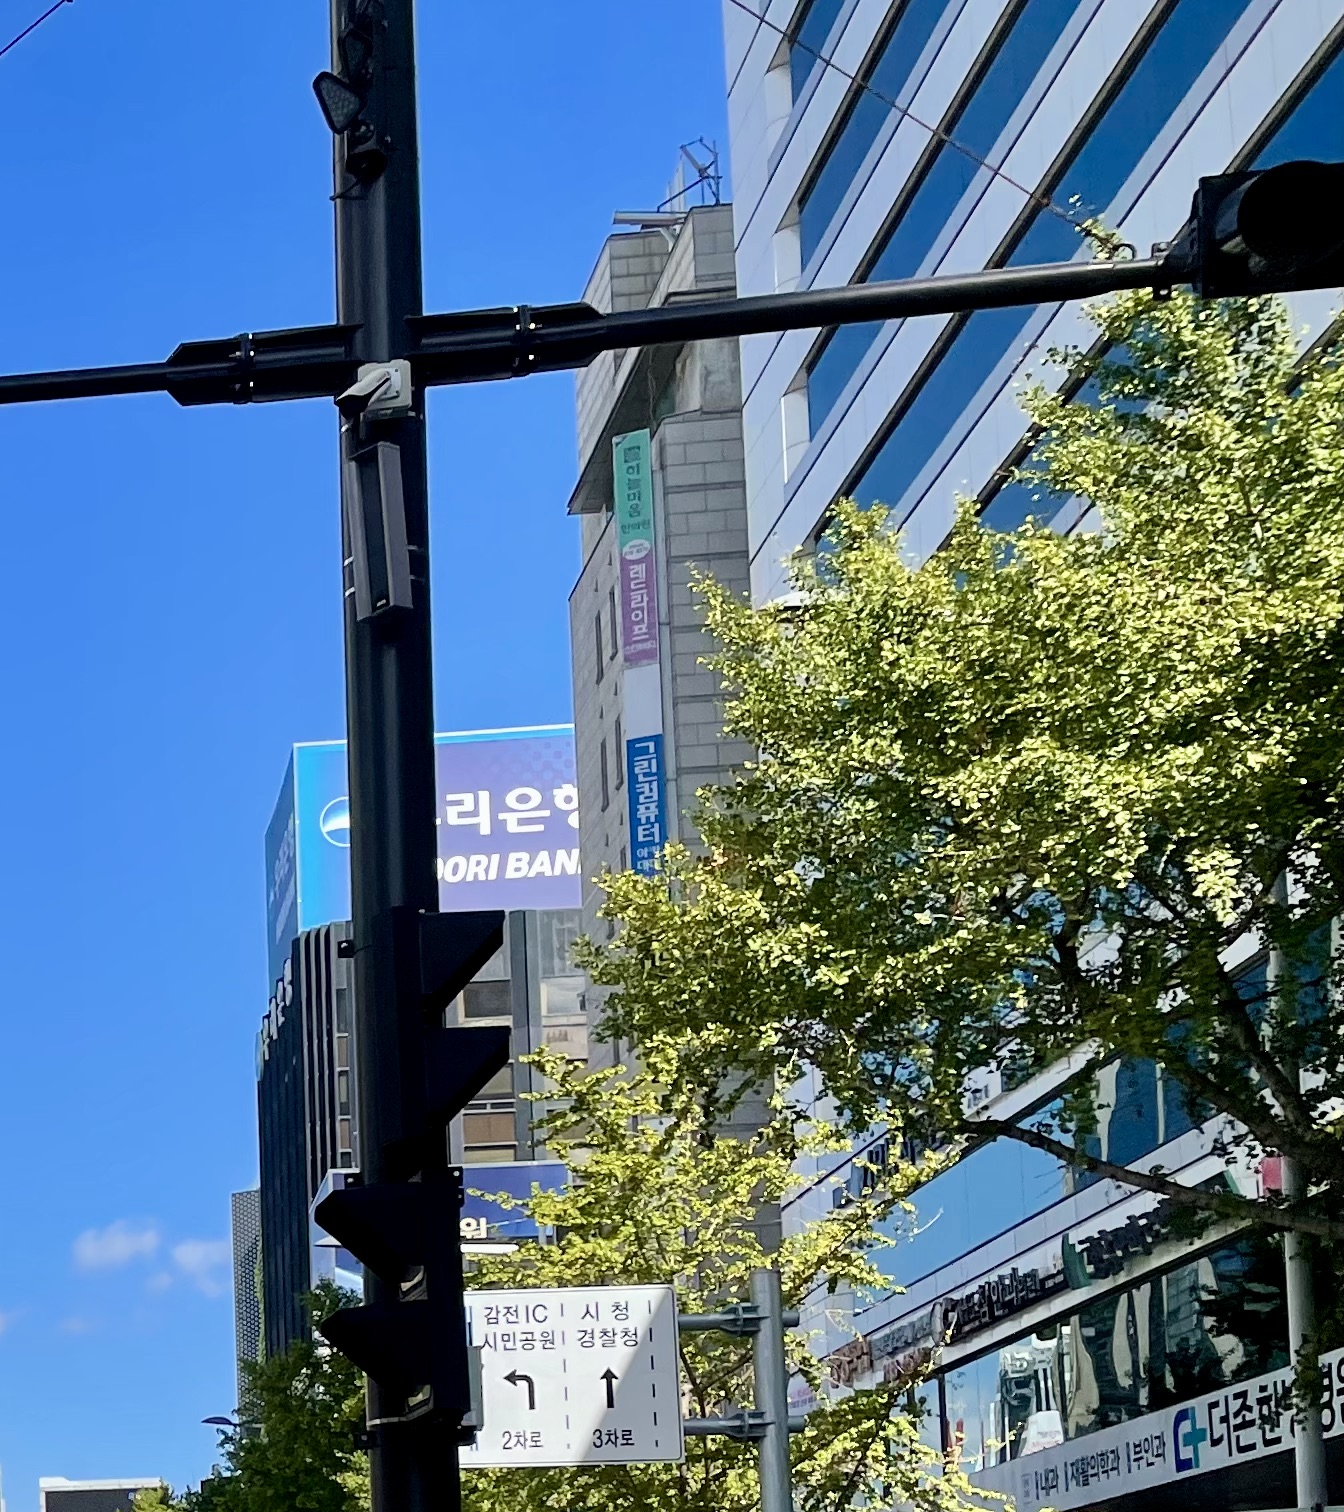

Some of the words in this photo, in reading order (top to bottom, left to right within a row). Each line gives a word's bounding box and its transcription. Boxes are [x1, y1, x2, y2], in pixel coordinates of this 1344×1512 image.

[633, 741, 661, 843] 그린컴퓨터
[436, 853, 501, 884] ORI
[504, 848, 582, 880] BAN
[483, 1304, 549, 1326] 감전IC
[480, 1330, 556, 1352] 시민공원
[576, 1328, 639, 1349] 경찰청
[501, 1430, 544, 1451] 2차로
[592, 1428, 635, 1449] 3차로
[1069, 1447, 1121, 1490] 재활의학과
[1132, 1431, 1167, 1472] 부인과
